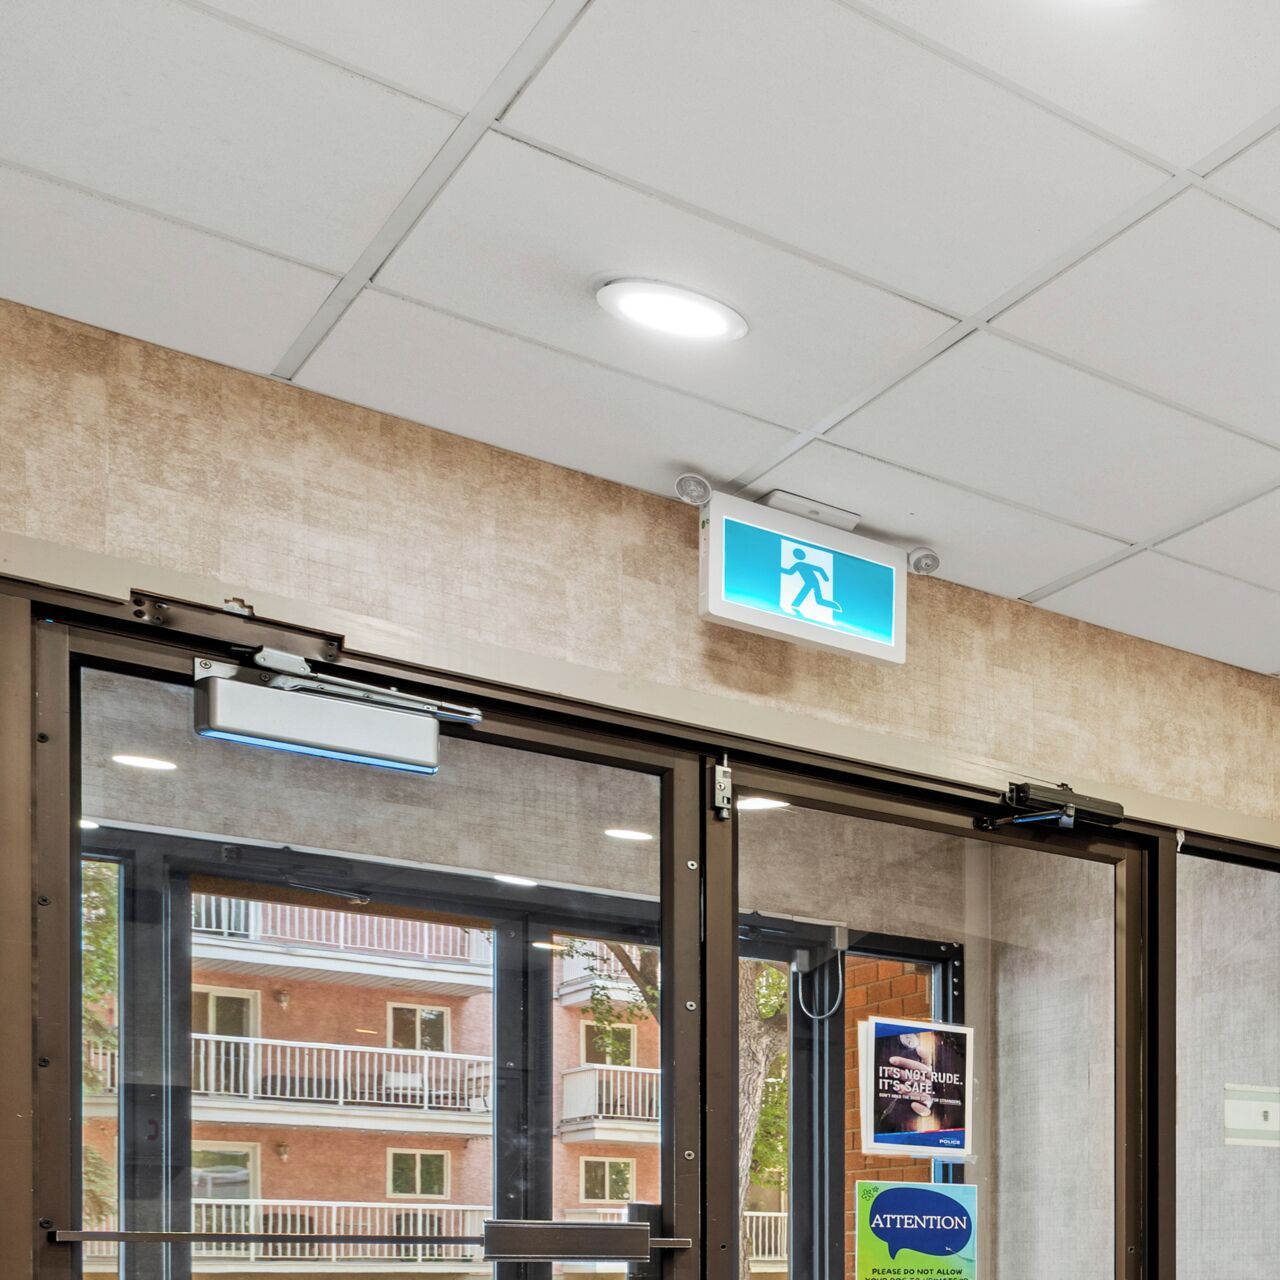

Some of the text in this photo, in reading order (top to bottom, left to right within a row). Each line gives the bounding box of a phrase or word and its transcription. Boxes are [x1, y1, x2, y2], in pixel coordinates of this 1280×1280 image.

[879, 1066, 963, 1085] IT'S NOT RUDE.
[879, 1079, 936, 1095] IT'S SAFE.
[871, 1214, 968, 1230] ATTENTION
